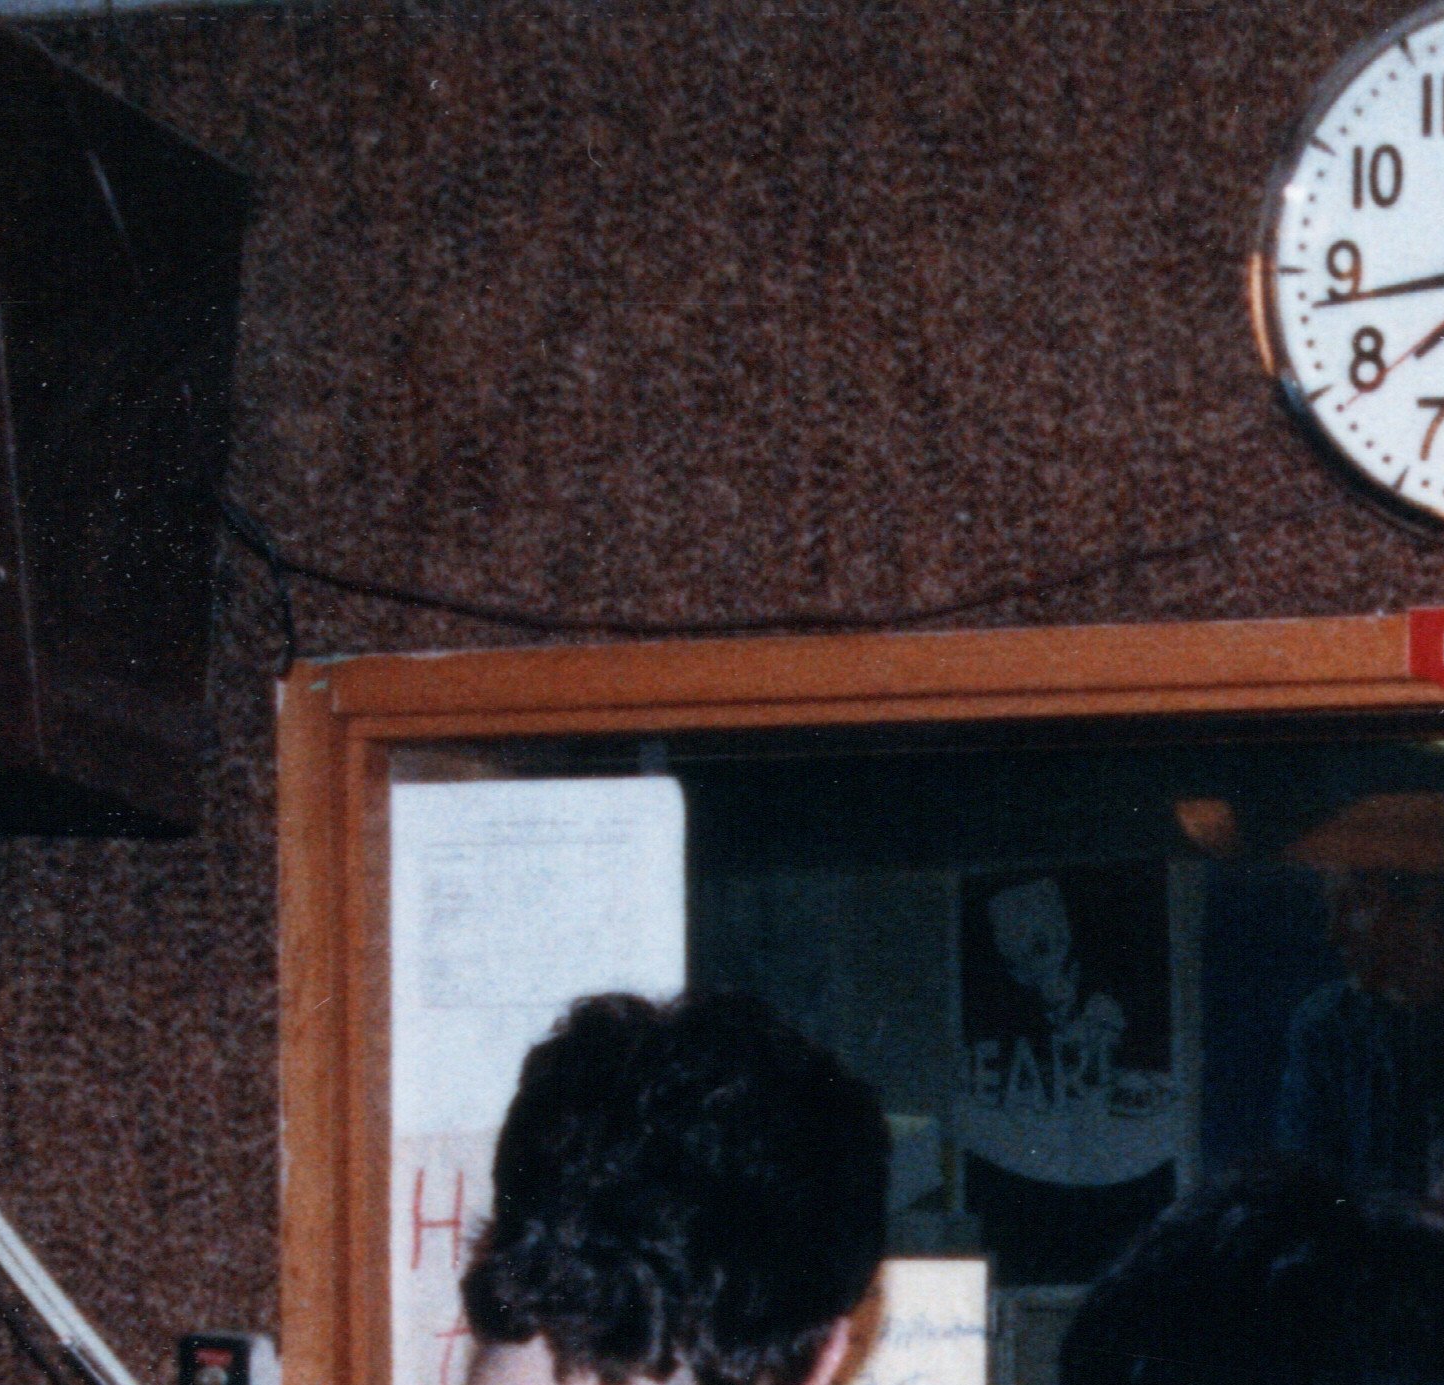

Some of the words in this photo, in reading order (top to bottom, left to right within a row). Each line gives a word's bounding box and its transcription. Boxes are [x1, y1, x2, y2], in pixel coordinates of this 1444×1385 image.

[1352, 143, 1404, 210] 10
[1326, 240, 1362, 302] 9
[1348, 325, 1386, 393] 8
